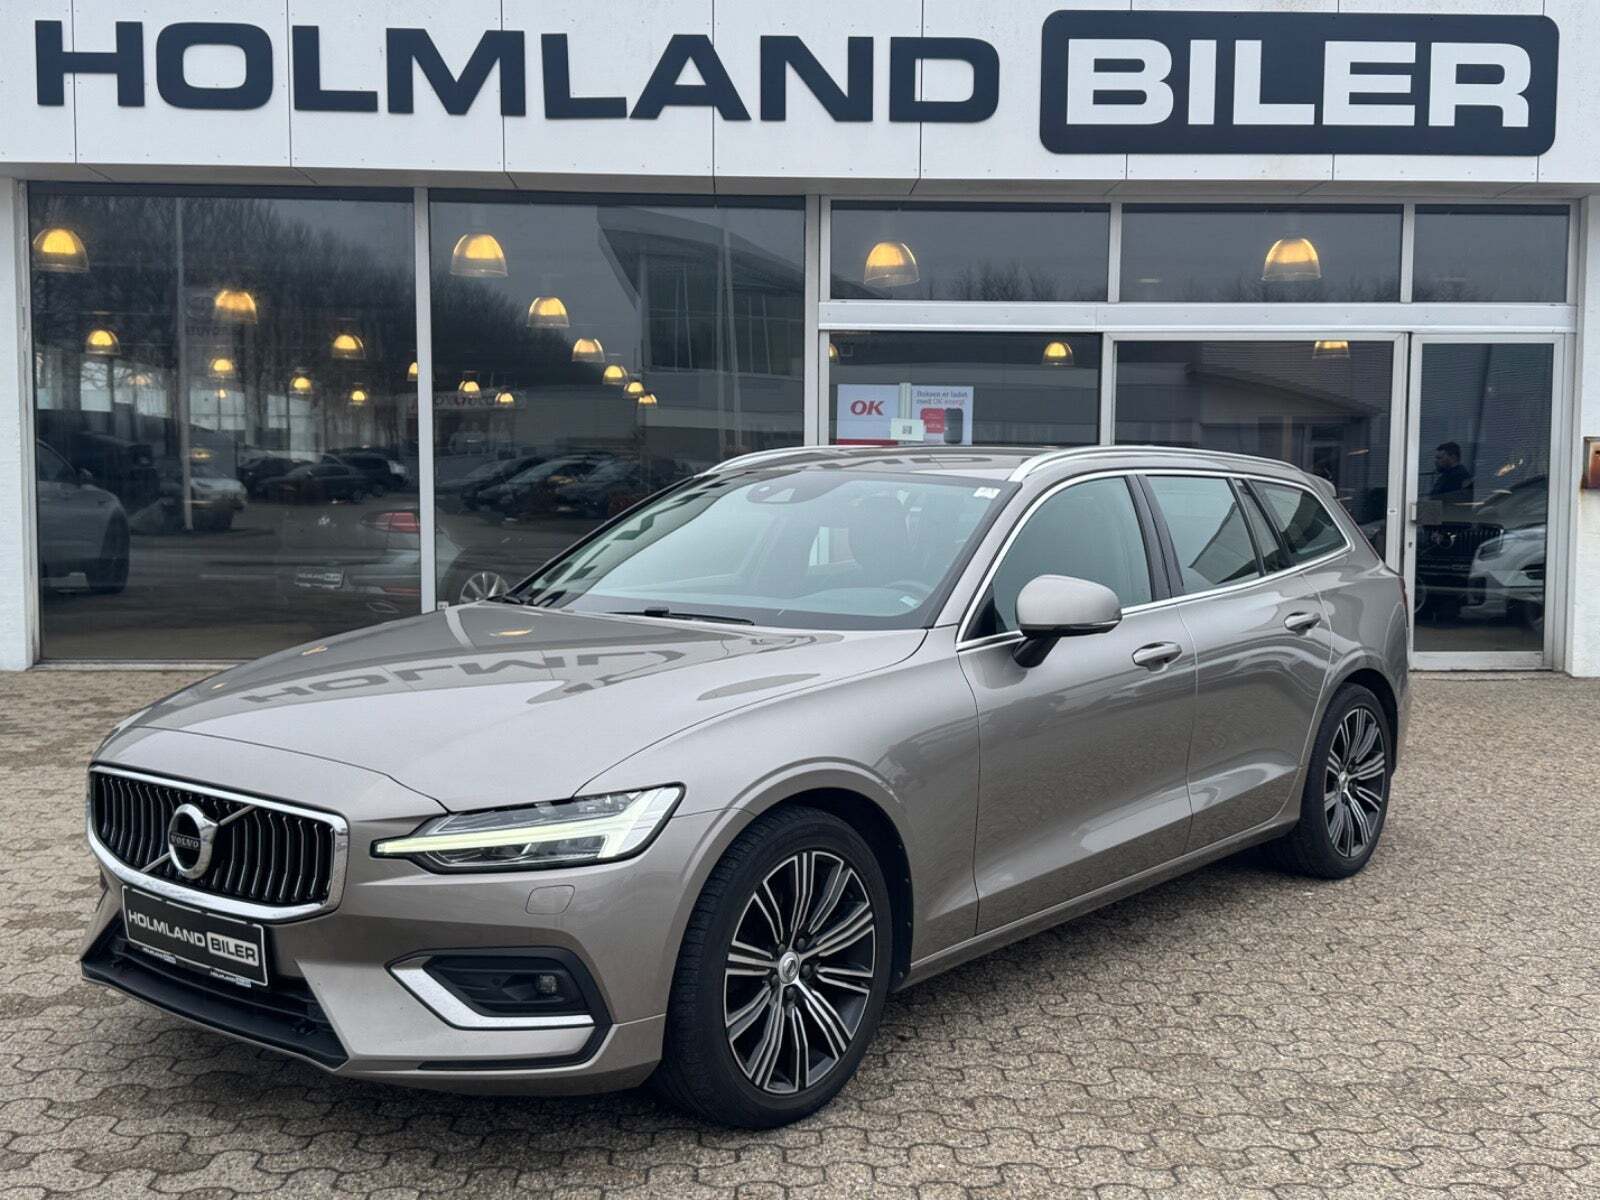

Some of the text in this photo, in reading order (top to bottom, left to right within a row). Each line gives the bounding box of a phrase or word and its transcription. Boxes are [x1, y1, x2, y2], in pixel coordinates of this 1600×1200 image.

[35, 20, 1532, 128] HOLMLAND BILER
[850, 400, 884, 416] OK
[170, 833, 199, 849] VOLVO
[128, 909, 206, 948] HOLMLAND
[210, 936, 257, 962] BILER
